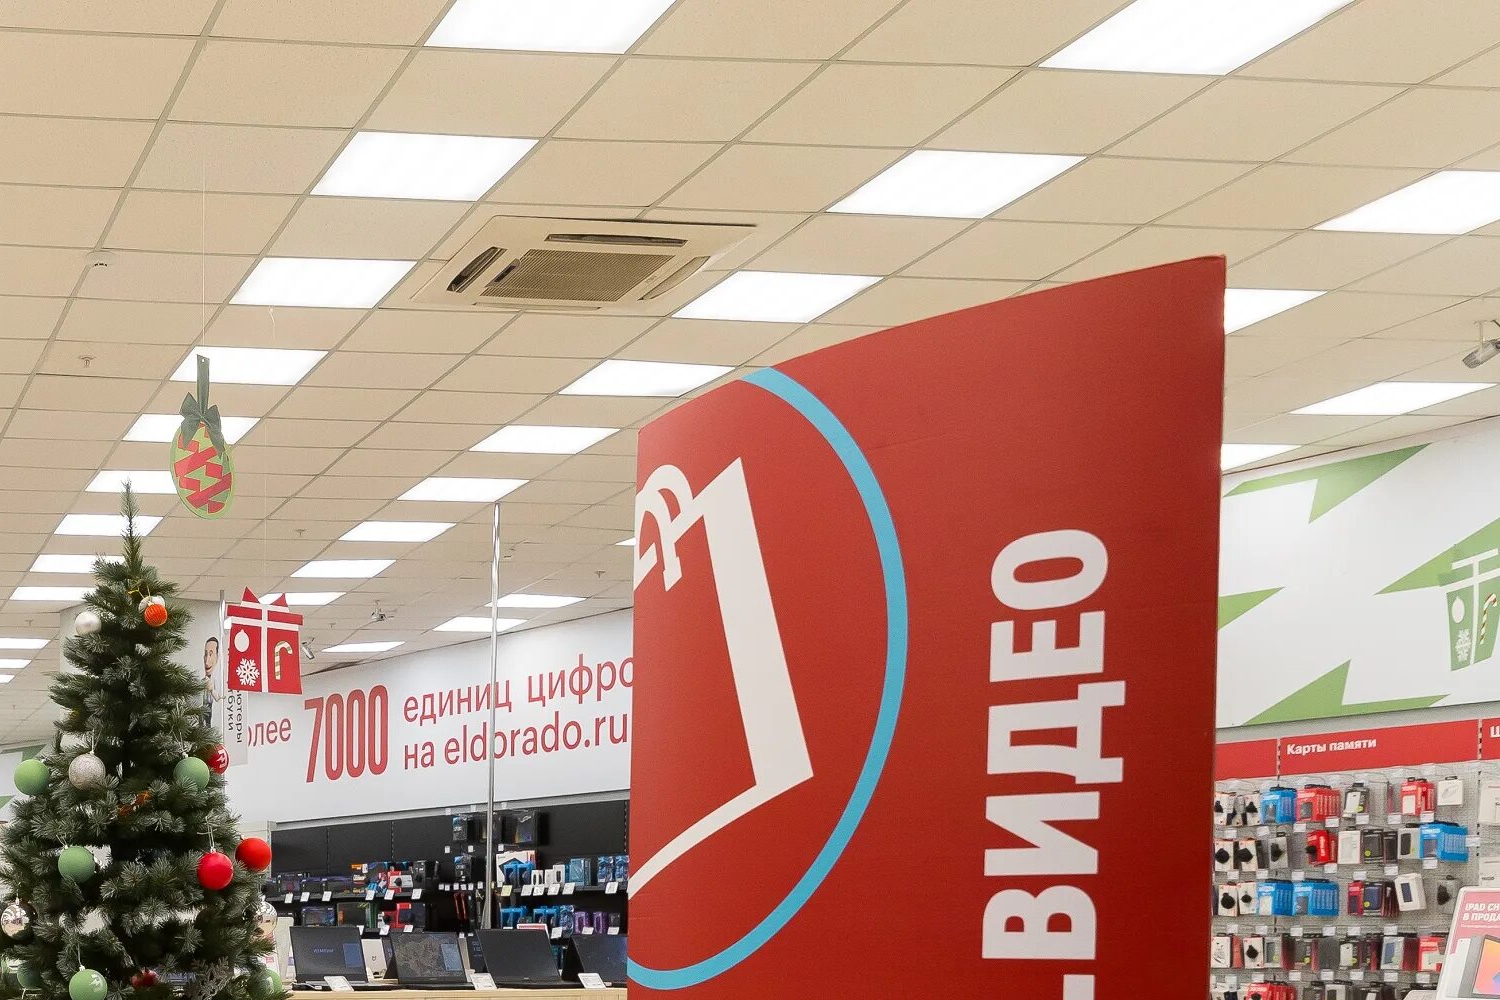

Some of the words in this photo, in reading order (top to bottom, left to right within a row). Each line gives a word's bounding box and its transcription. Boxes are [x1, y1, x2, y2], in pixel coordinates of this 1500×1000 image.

[304, 684, 389, 783] 7000
[403, 679, 512, 727] единиц
[404, 743, 436, 770] на
[443, 711, 628, 766] eldorado.ru
[1286, 742, 1326, 756] Карты
[1329, 738, 1377, 751] памяти
